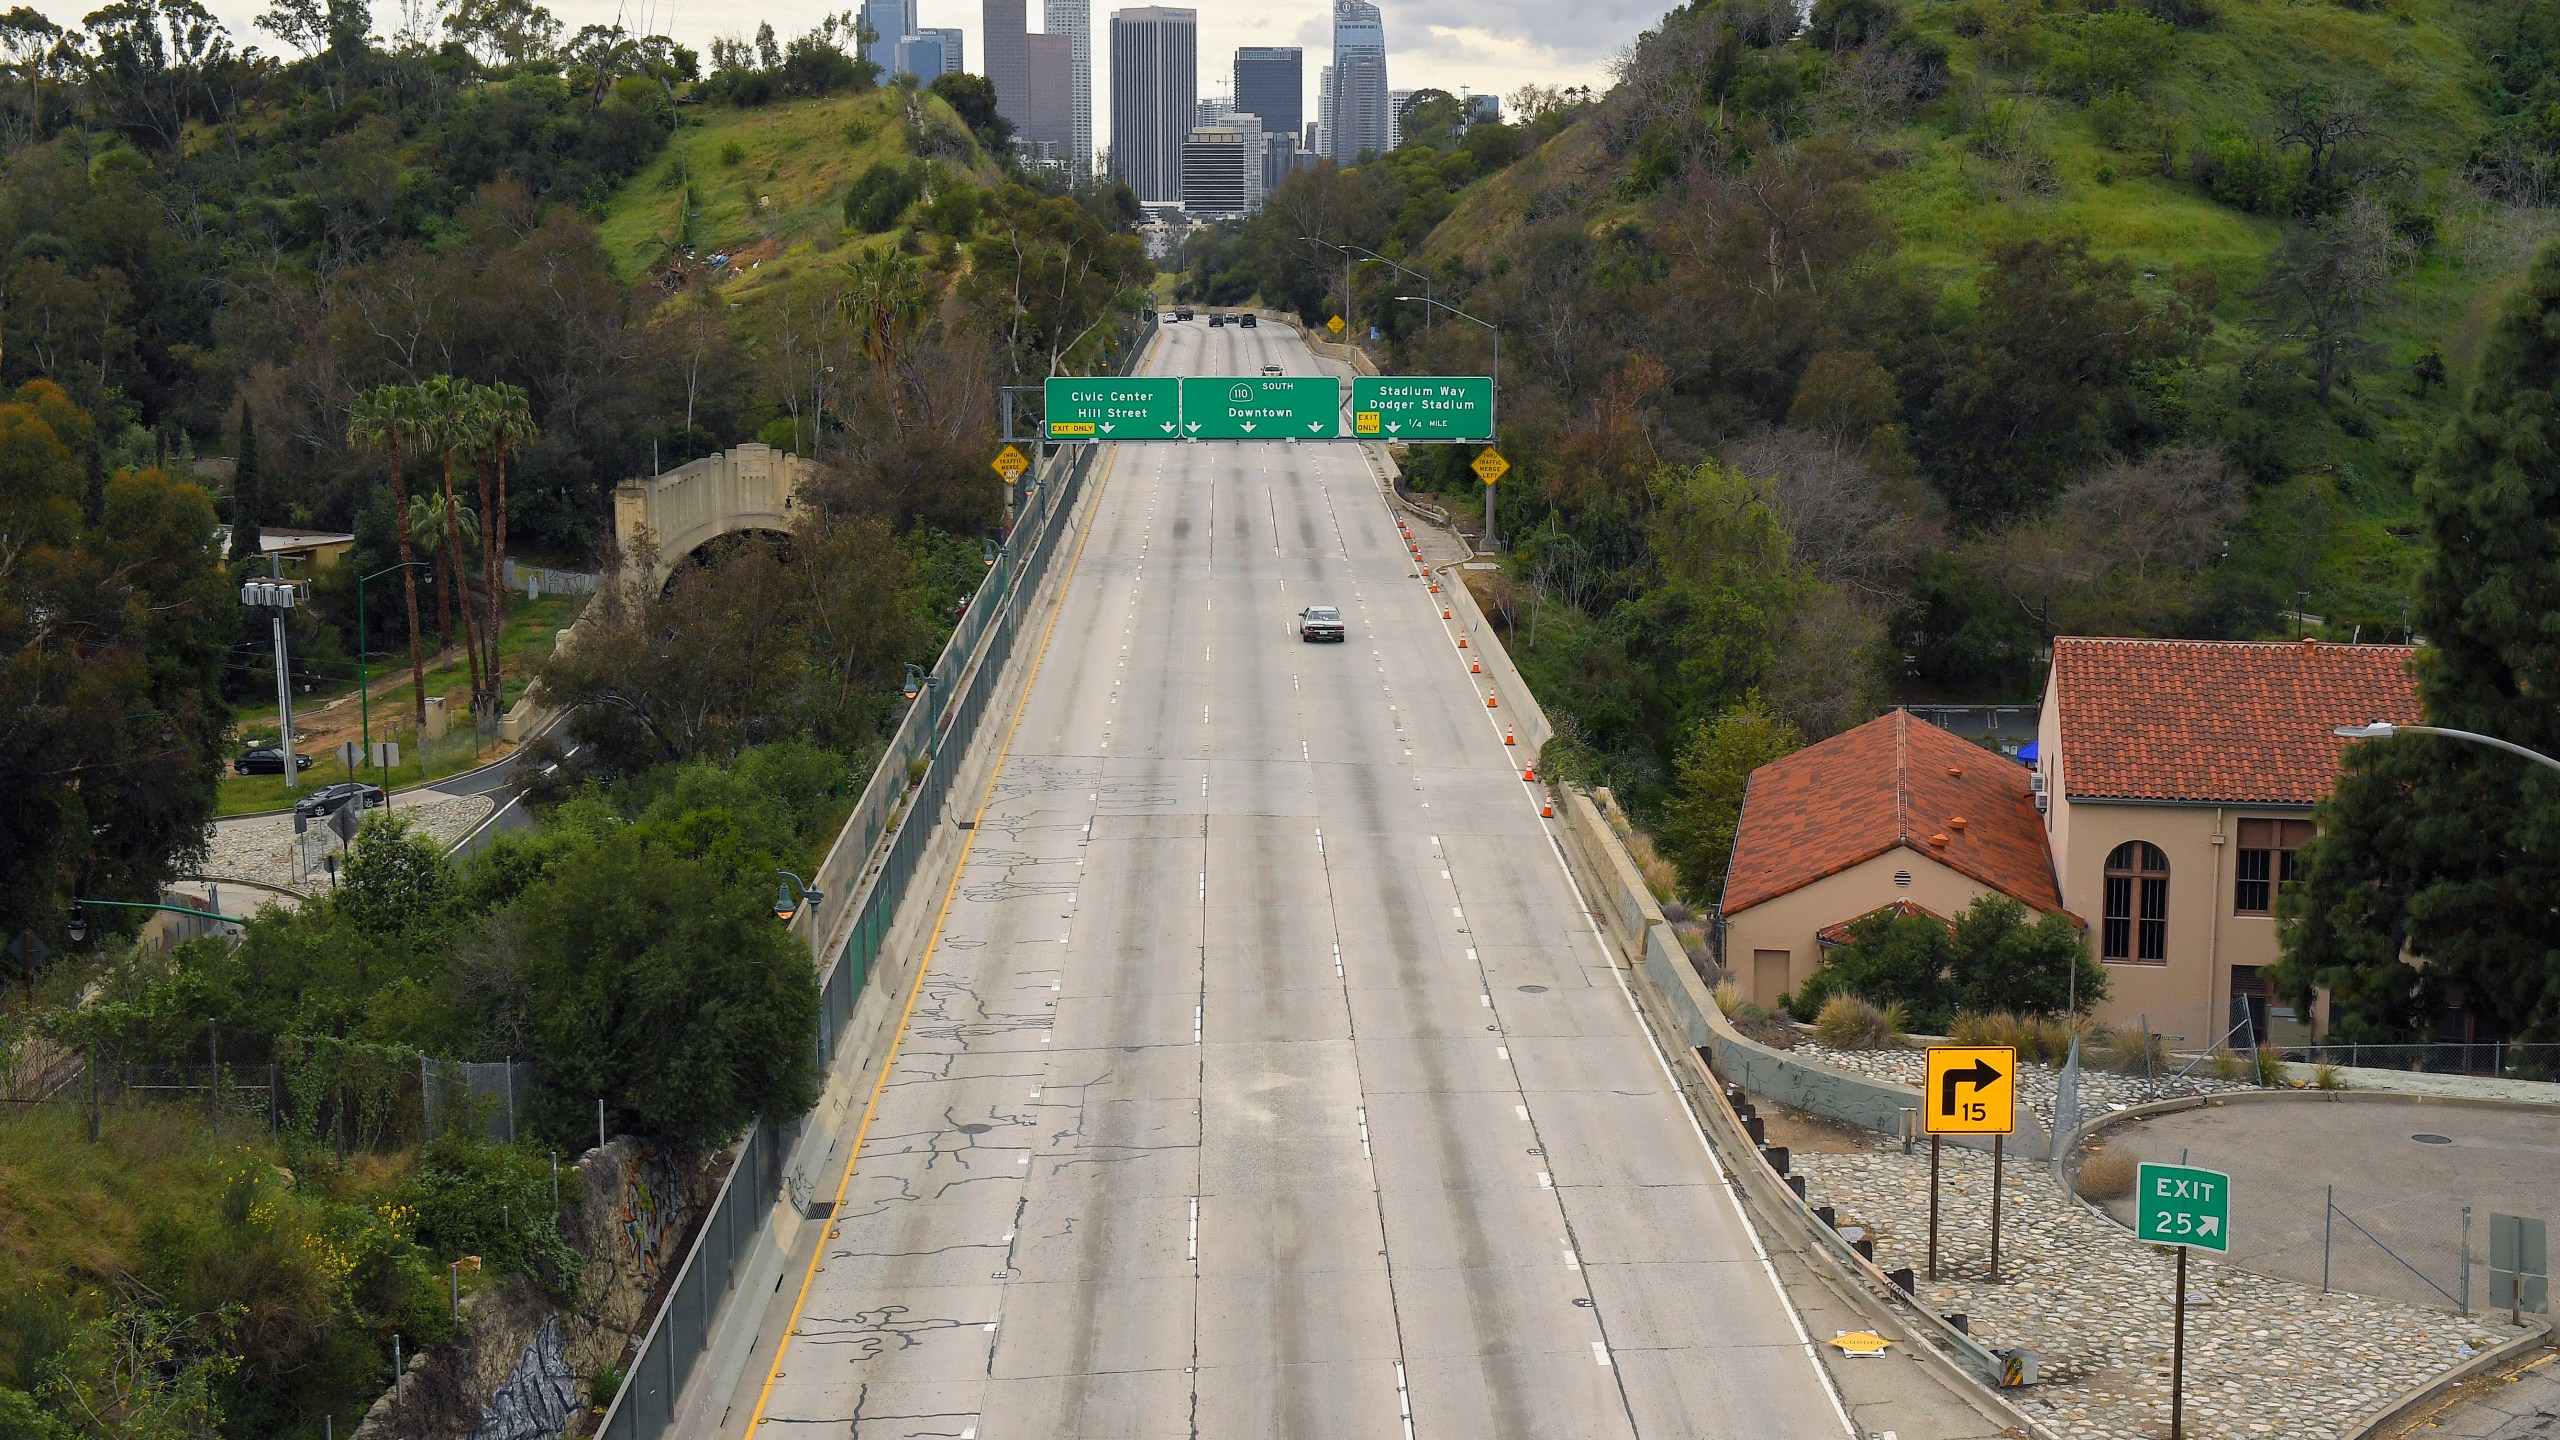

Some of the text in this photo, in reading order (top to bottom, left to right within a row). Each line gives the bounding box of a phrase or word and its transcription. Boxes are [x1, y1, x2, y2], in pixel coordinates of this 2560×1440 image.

[1262, 382, 1294, 390] SOUTH
[1071, 391, 1154, 402] Civic Center
[1234, 389, 1248, 398] 110
[1379, 386, 1466, 398] Stadium Way
[1370, 400, 1475, 411] Dodger Stadium
[1078, 408, 1148, 418] Hill Street
[1228, 407, 1293, 418] Downtown
[1962, 1102, 1986, 1122] 15
[2156, 1177, 2215, 1202] EXIT
[2156, 1211, 2192, 1235] 25
